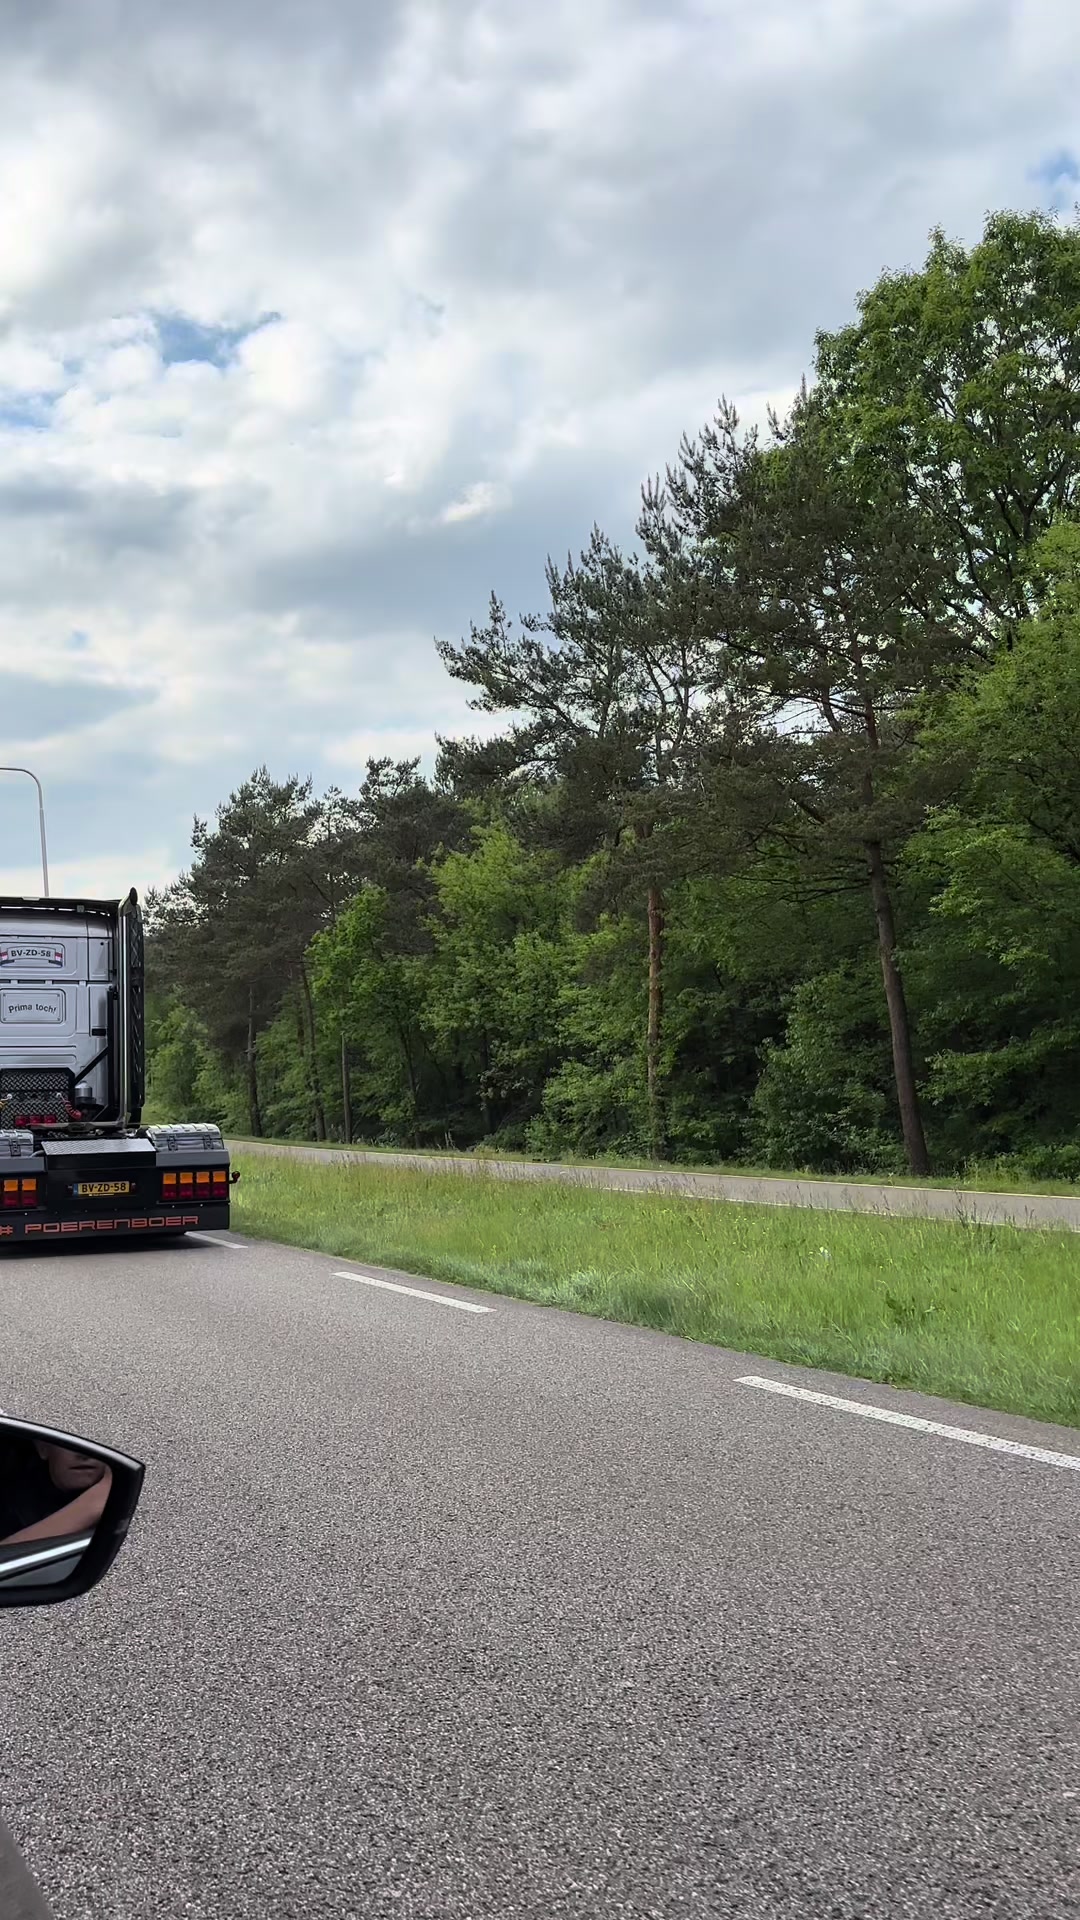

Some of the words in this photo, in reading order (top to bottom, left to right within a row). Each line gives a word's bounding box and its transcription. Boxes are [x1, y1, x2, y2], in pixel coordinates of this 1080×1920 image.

[11, 949, 51, 957] BV-ZD-58
[8, 1004, 33, 1013] Prima
[81, 1182, 126, 1193] BV-ZD-58
